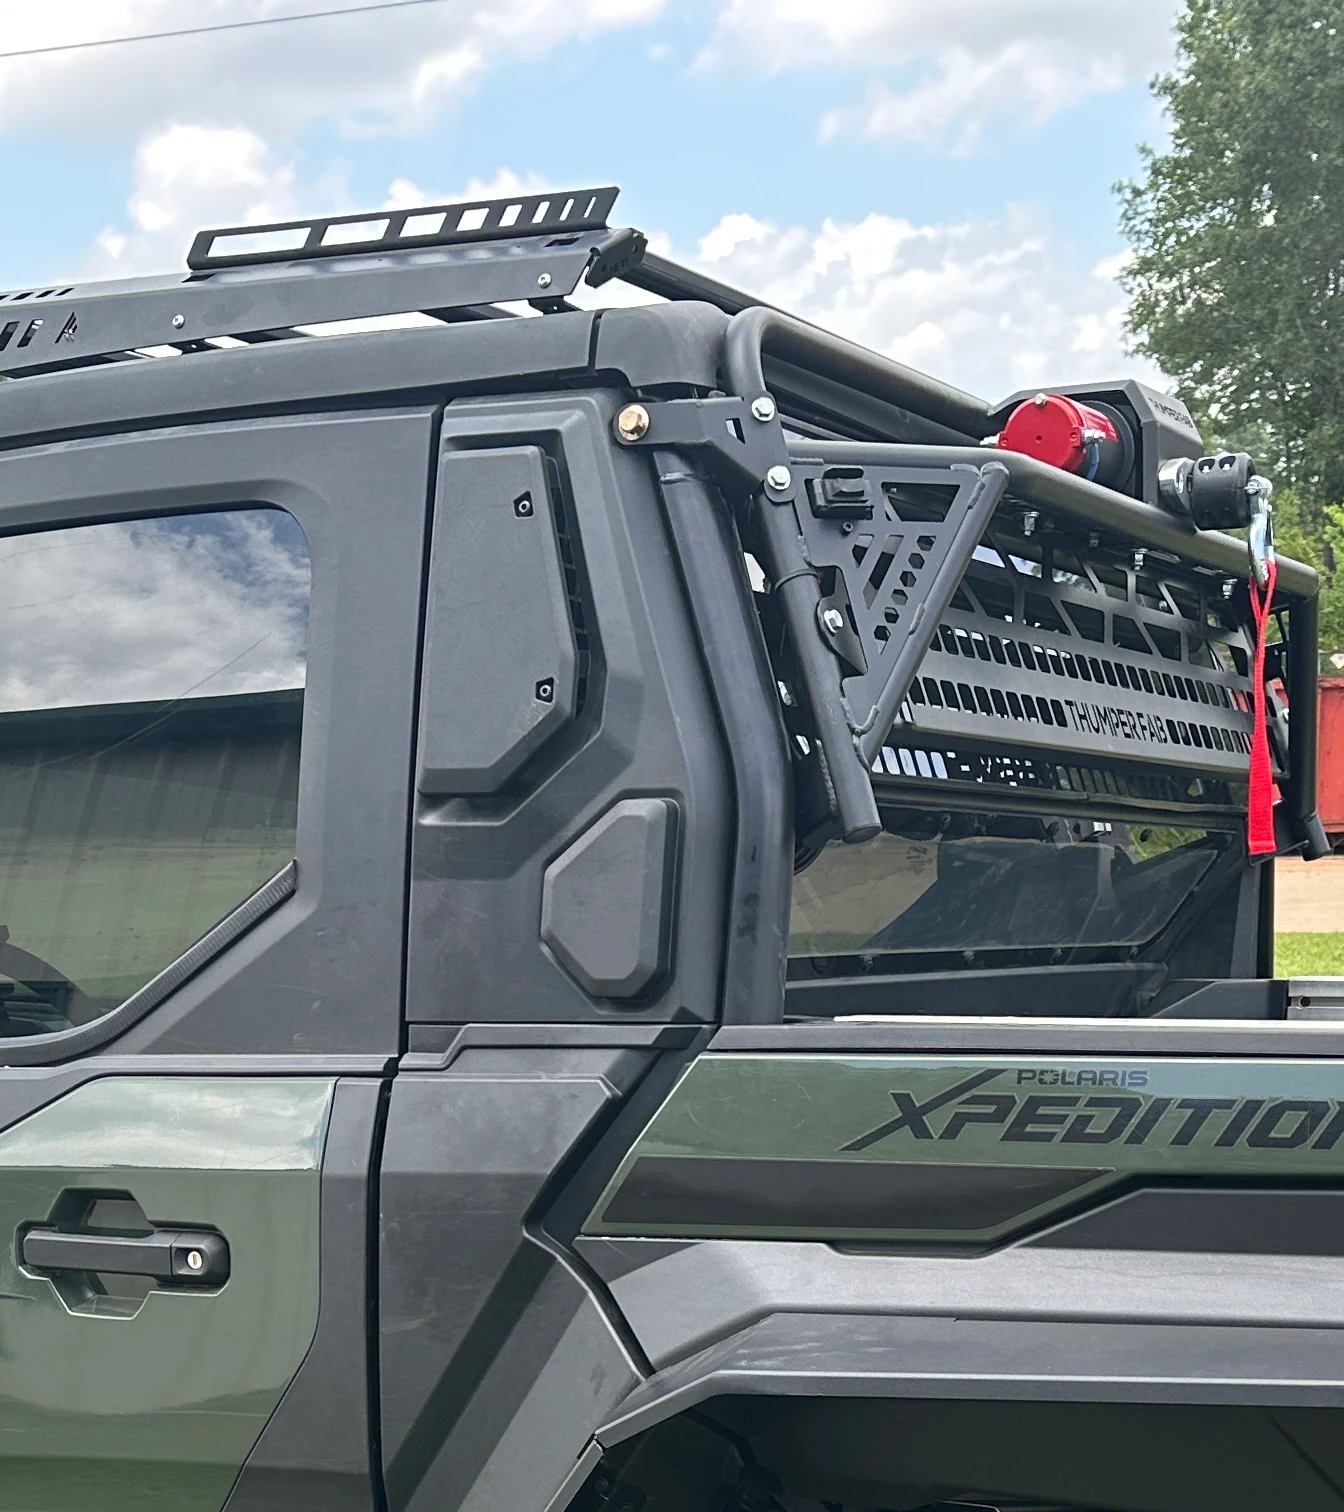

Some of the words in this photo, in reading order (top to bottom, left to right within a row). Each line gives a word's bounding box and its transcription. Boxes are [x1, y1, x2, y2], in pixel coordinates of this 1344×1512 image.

[1064, 699, 1141, 741] THUMPER
[1136, 711, 1168, 744] FAB
[1016, 1067, 1149, 1088] POLARIS
